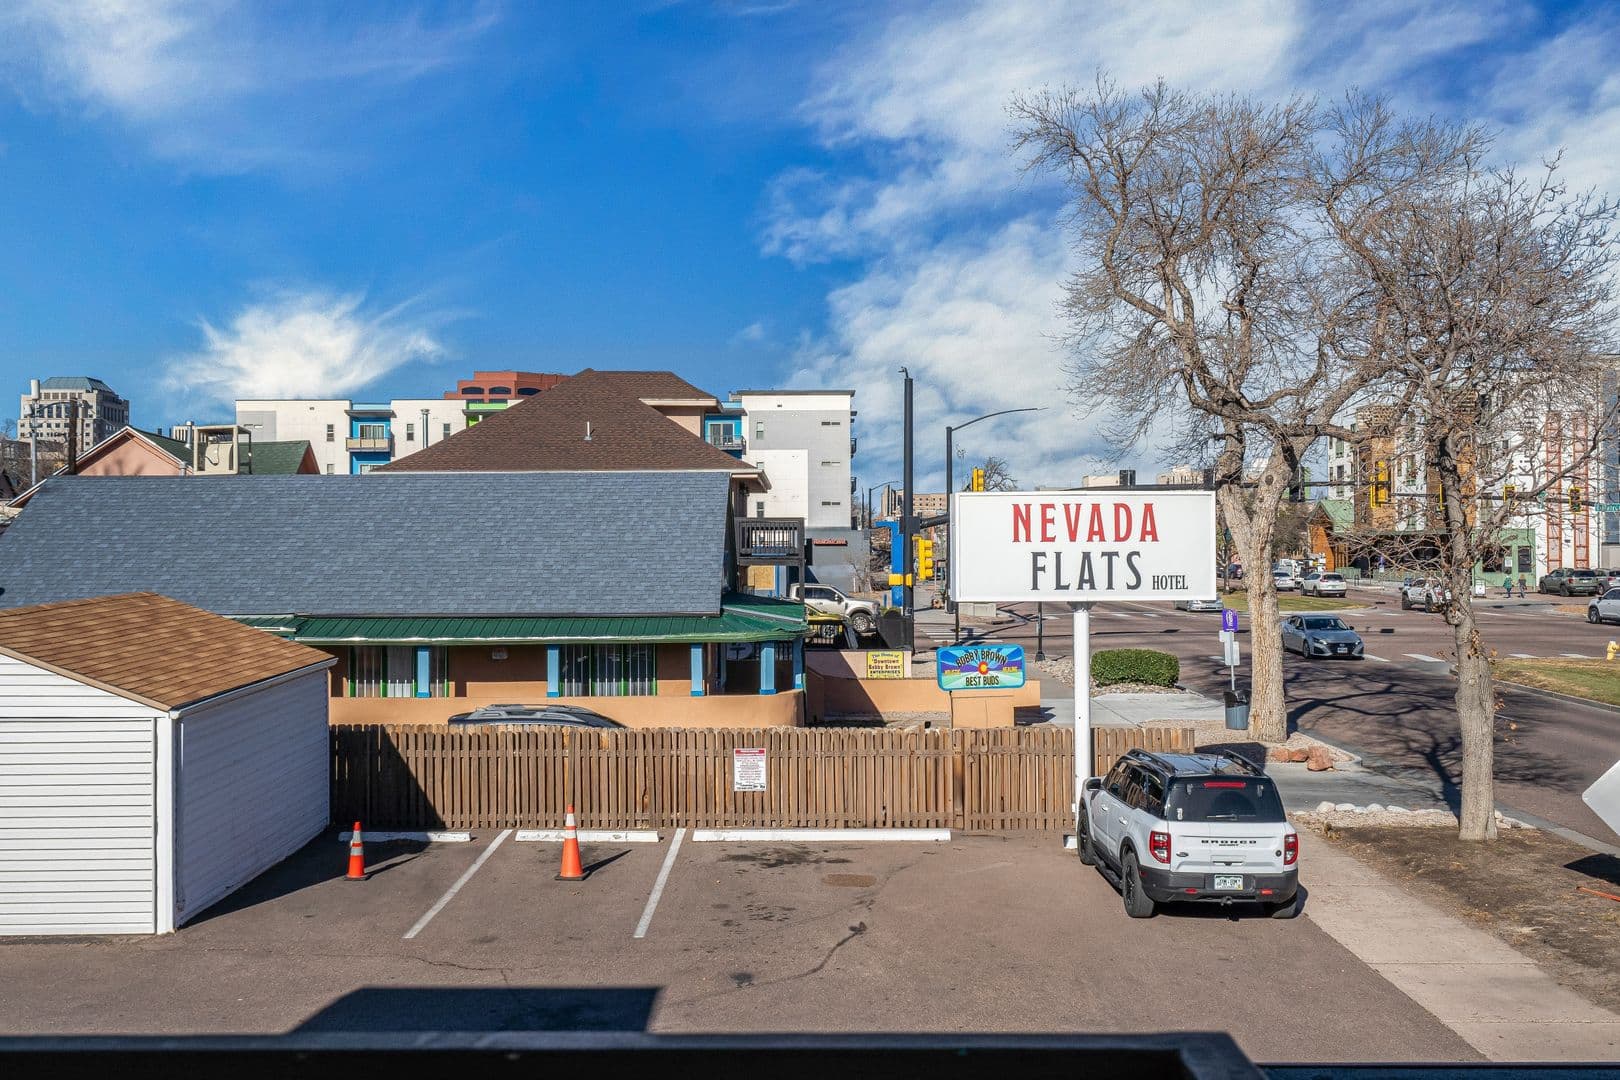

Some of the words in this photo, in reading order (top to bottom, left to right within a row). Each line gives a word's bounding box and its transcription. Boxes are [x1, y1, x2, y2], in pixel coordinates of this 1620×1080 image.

[1011, 502, 1160, 543] NEVADA
[1030, 550, 1142, 591] FLATS
[1152, 574, 1189, 591] HOTEL
[955, 650, 979, 667] BOBBY
[981, 650, 1009, 666] BROWN
[965, 676, 981, 686] BEST
[983, 675, 1000, 686] BUDS
